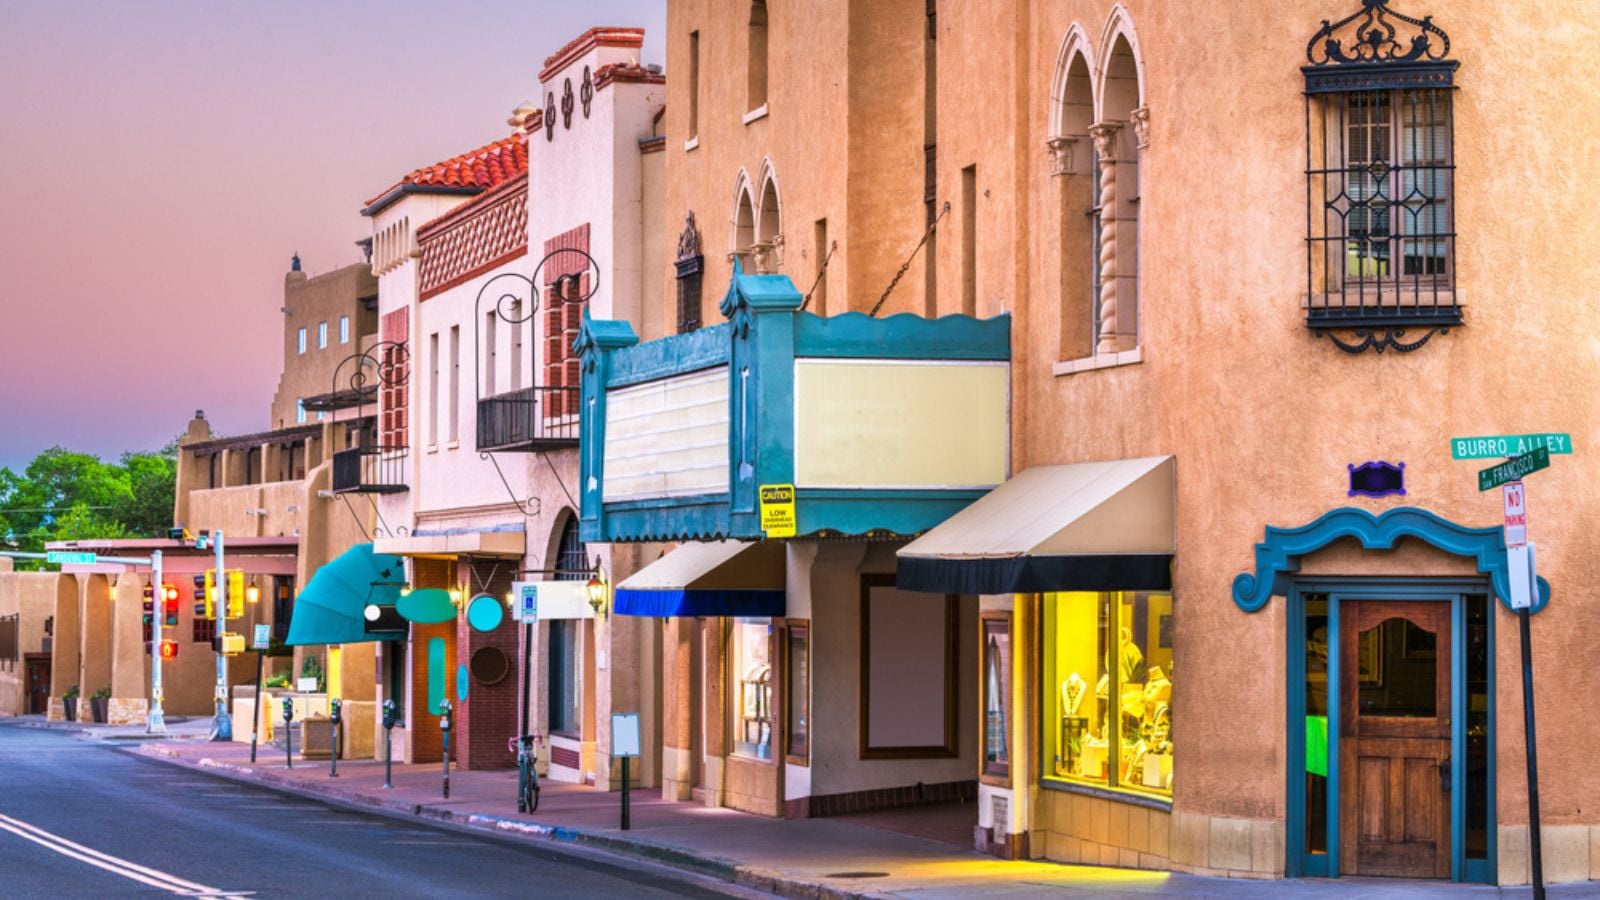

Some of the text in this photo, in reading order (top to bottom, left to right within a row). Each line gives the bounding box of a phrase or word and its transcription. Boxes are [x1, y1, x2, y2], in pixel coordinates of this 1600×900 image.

[1457, 439, 1507, 456] BURRO
[1493, 455, 1534, 483] FRANCISCO
[763, 490, 792, 499] CAUTION
[1508, 491, 1521, 507] NO
[1504, 514, 1526, 526] PARKING
